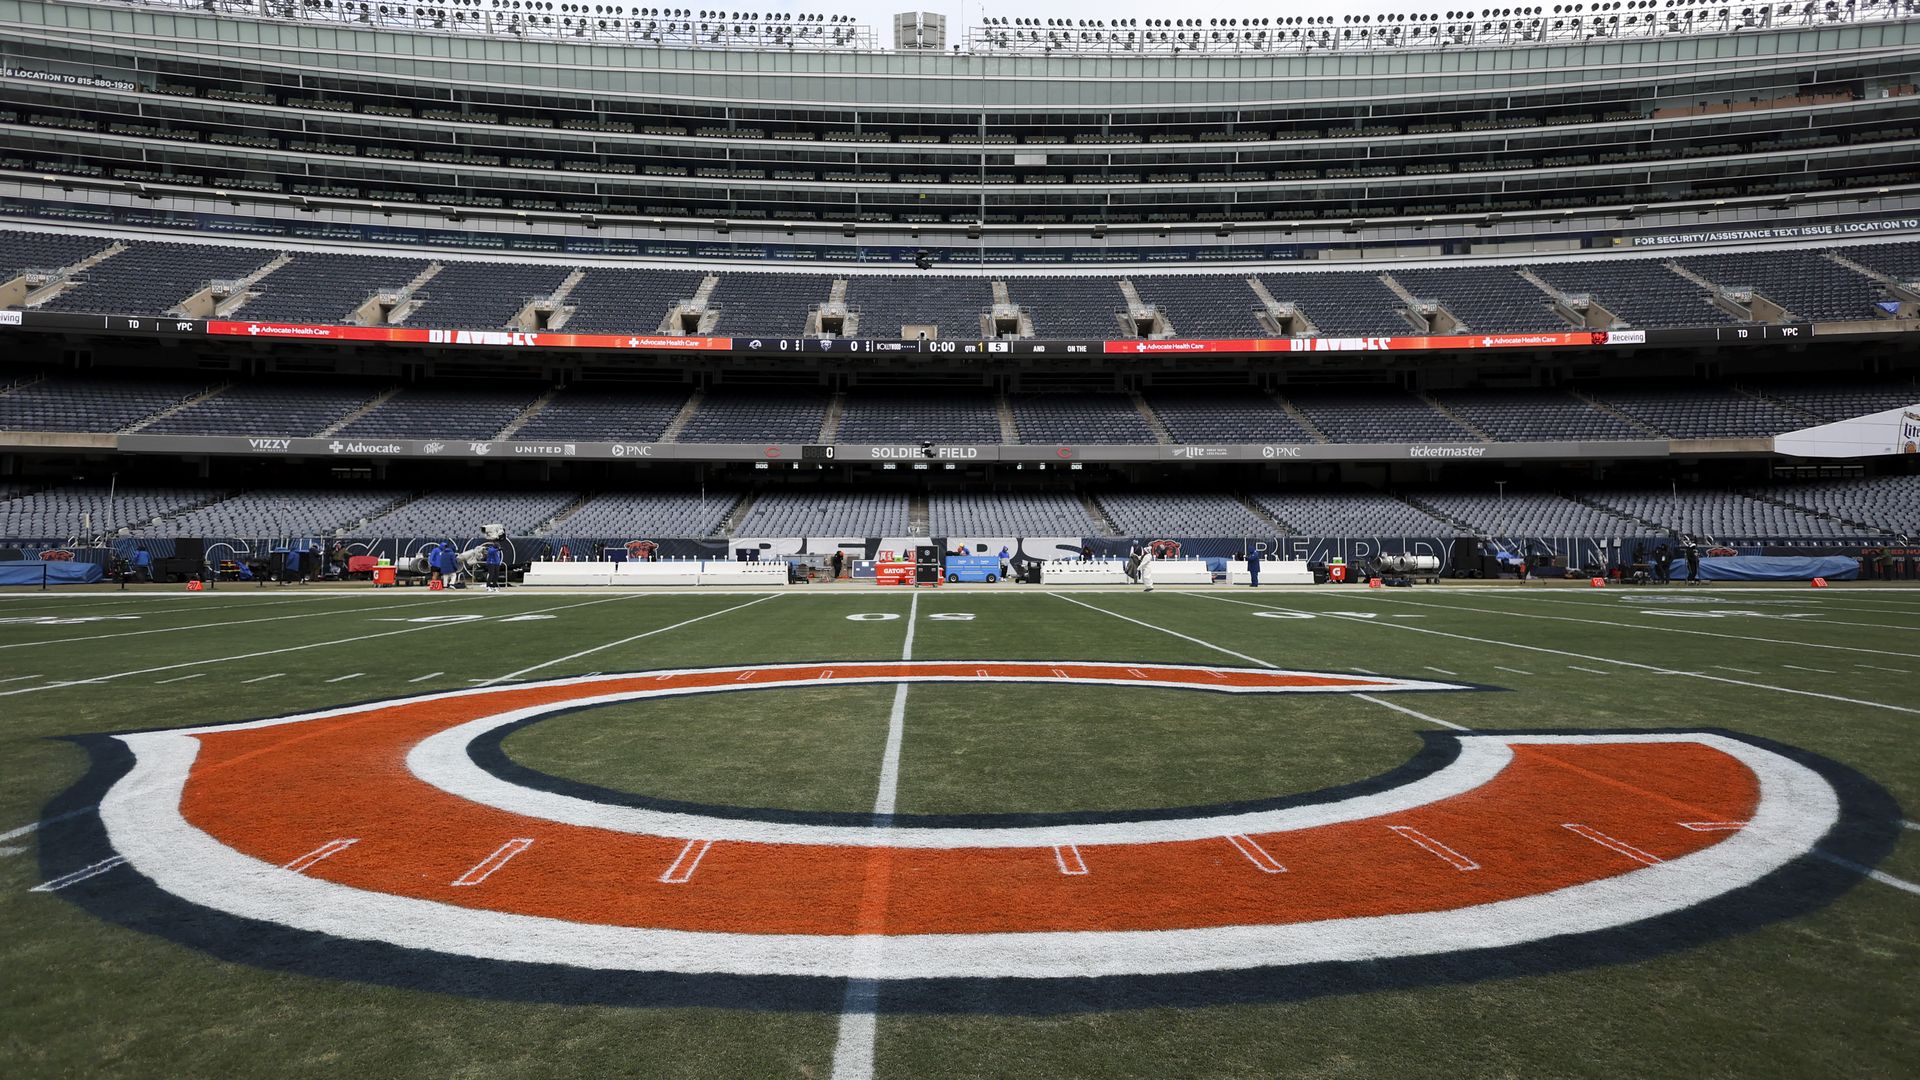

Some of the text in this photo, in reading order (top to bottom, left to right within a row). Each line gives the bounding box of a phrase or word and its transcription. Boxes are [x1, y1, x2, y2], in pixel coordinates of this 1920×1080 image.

[15, 70, 61, 82] LOCATION
[63, 75, 76, 83] TO
[77, 77, 135, 90] 815-880-1920
[1635, 219, 1918, 246] FOR SECURITY/ASSISTANCE TEXT ISSUE & LOCATION TO
[128, 319, 140, 329] TD
[176, 322, 193, 331] YPC
[261, 326, 291, 334] Advocate
[1737, 329, 1748, 338] TD
[1782, 328, 1798, 336] YPC
[1612, 334, 1644, 343] Receiving
[780, 340, 788, 350] 0
[850, 341, 858, 351] 0
[929, 341, 956, 352] 0:00
[964, 342, 1002, 353] QTR 1 5
[249, 439, 291, 449] VIZZY
[346, 442, 400, 454] Advocate
[626, 446, 652, 456] PNC
[826, 447, 833, 458] 0
[939, 447, 977, 458] FIELD
[1185, 446, 1205, 458] Lite
[1276, 447, 1301, 457] PNC
[1410, 446, 1486, 457] ticketmaster
[1332, 567, 1341, 577] G
